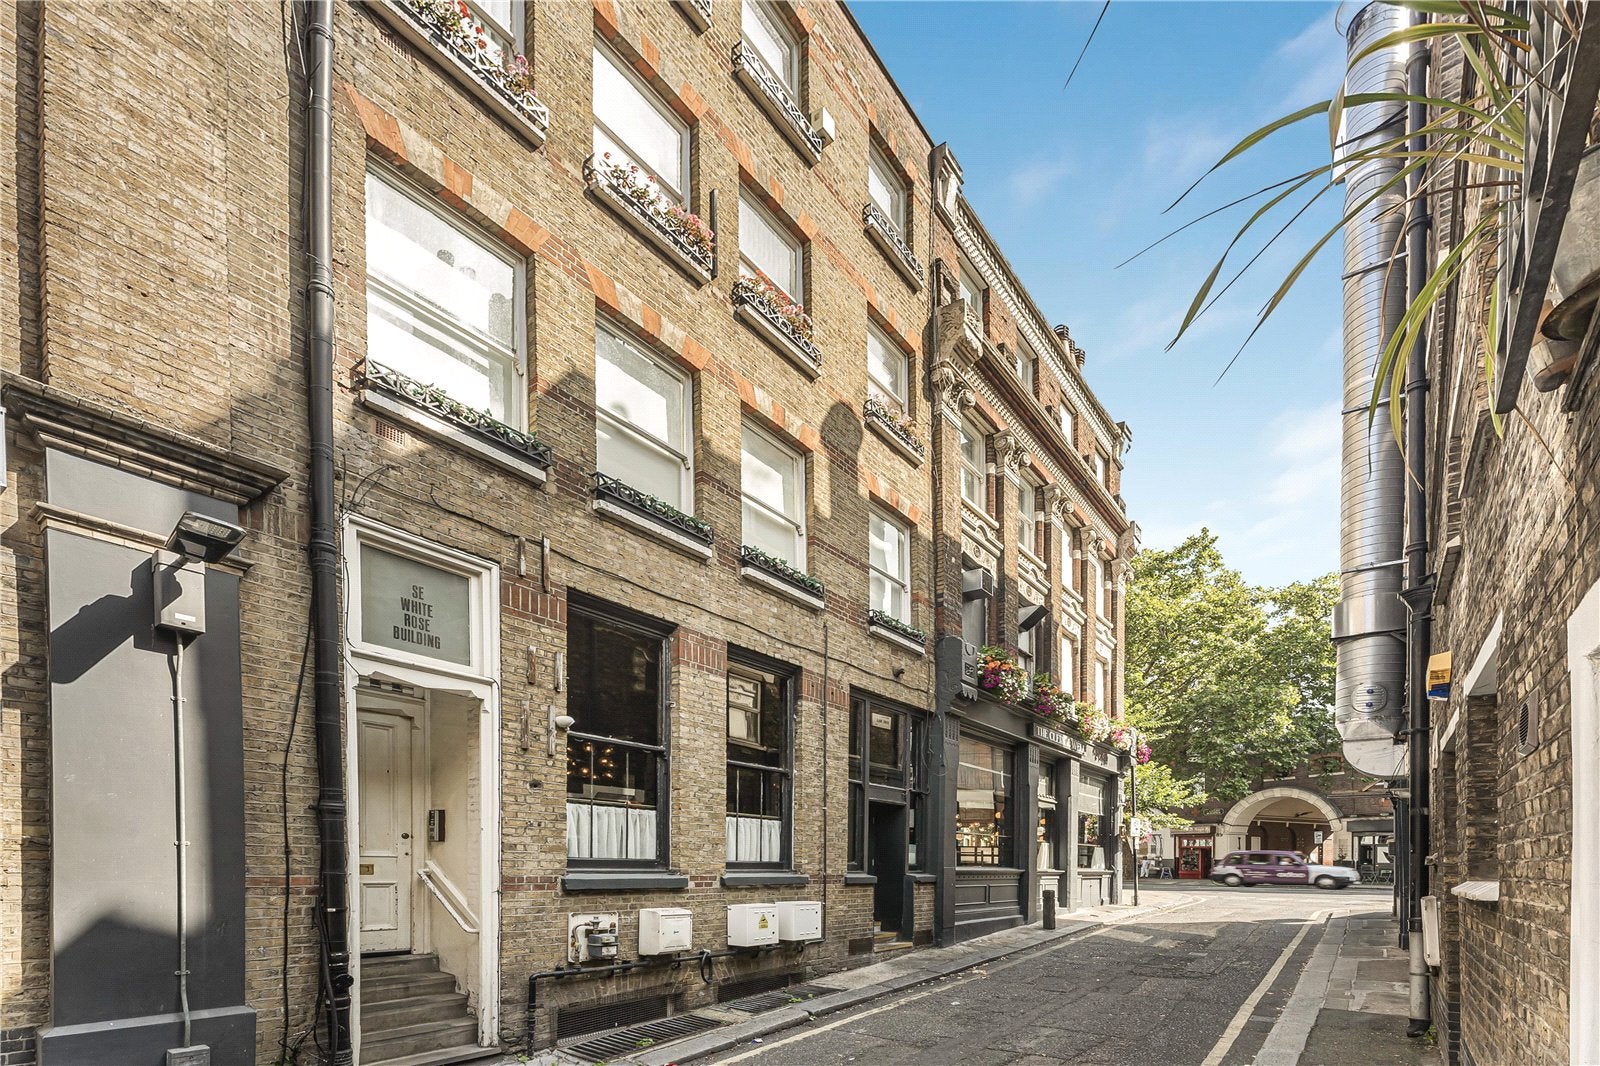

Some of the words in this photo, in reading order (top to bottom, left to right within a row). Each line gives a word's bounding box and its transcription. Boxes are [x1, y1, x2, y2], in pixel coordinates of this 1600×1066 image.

[412, 585, 424, 600] SE
[401, 597, 433, 618] WHITE
[404, 613, 430, 632] ROSE
[393, 625, 440, 649] BUILDING
[1036, 725, 1049, 740] THE
